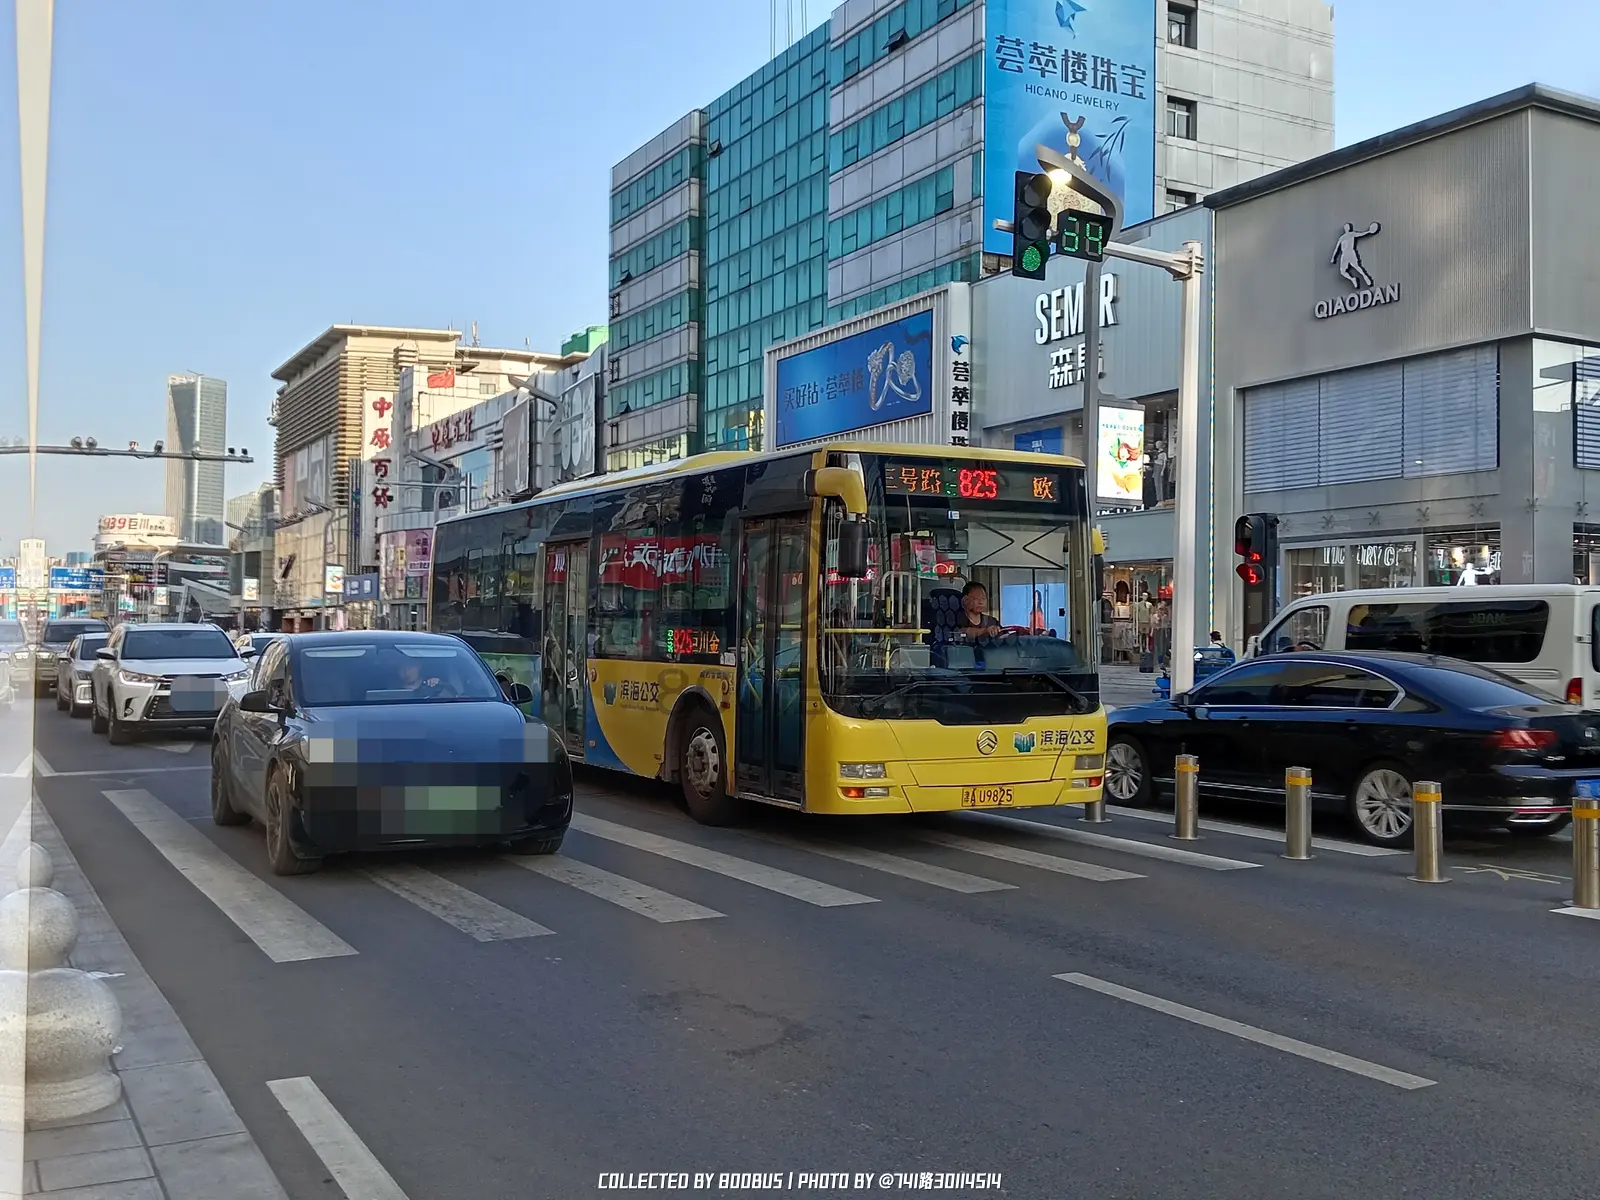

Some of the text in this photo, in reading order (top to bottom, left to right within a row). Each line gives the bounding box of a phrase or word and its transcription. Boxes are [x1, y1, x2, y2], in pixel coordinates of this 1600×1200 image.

[995, 34, 1147, 100] 荟萃楼珠宝
[1025, 83, 1120, 112] HICANO JEWELRY
[1035, 273, 1115, 344] SEMR
[1314, 283, 1400, 319] QIAODAN
[959, 469, 998, 499] 825
[620, 679, 660, 703] 滨海公交
[1040, 729, 1096, 746] 滨海公交
